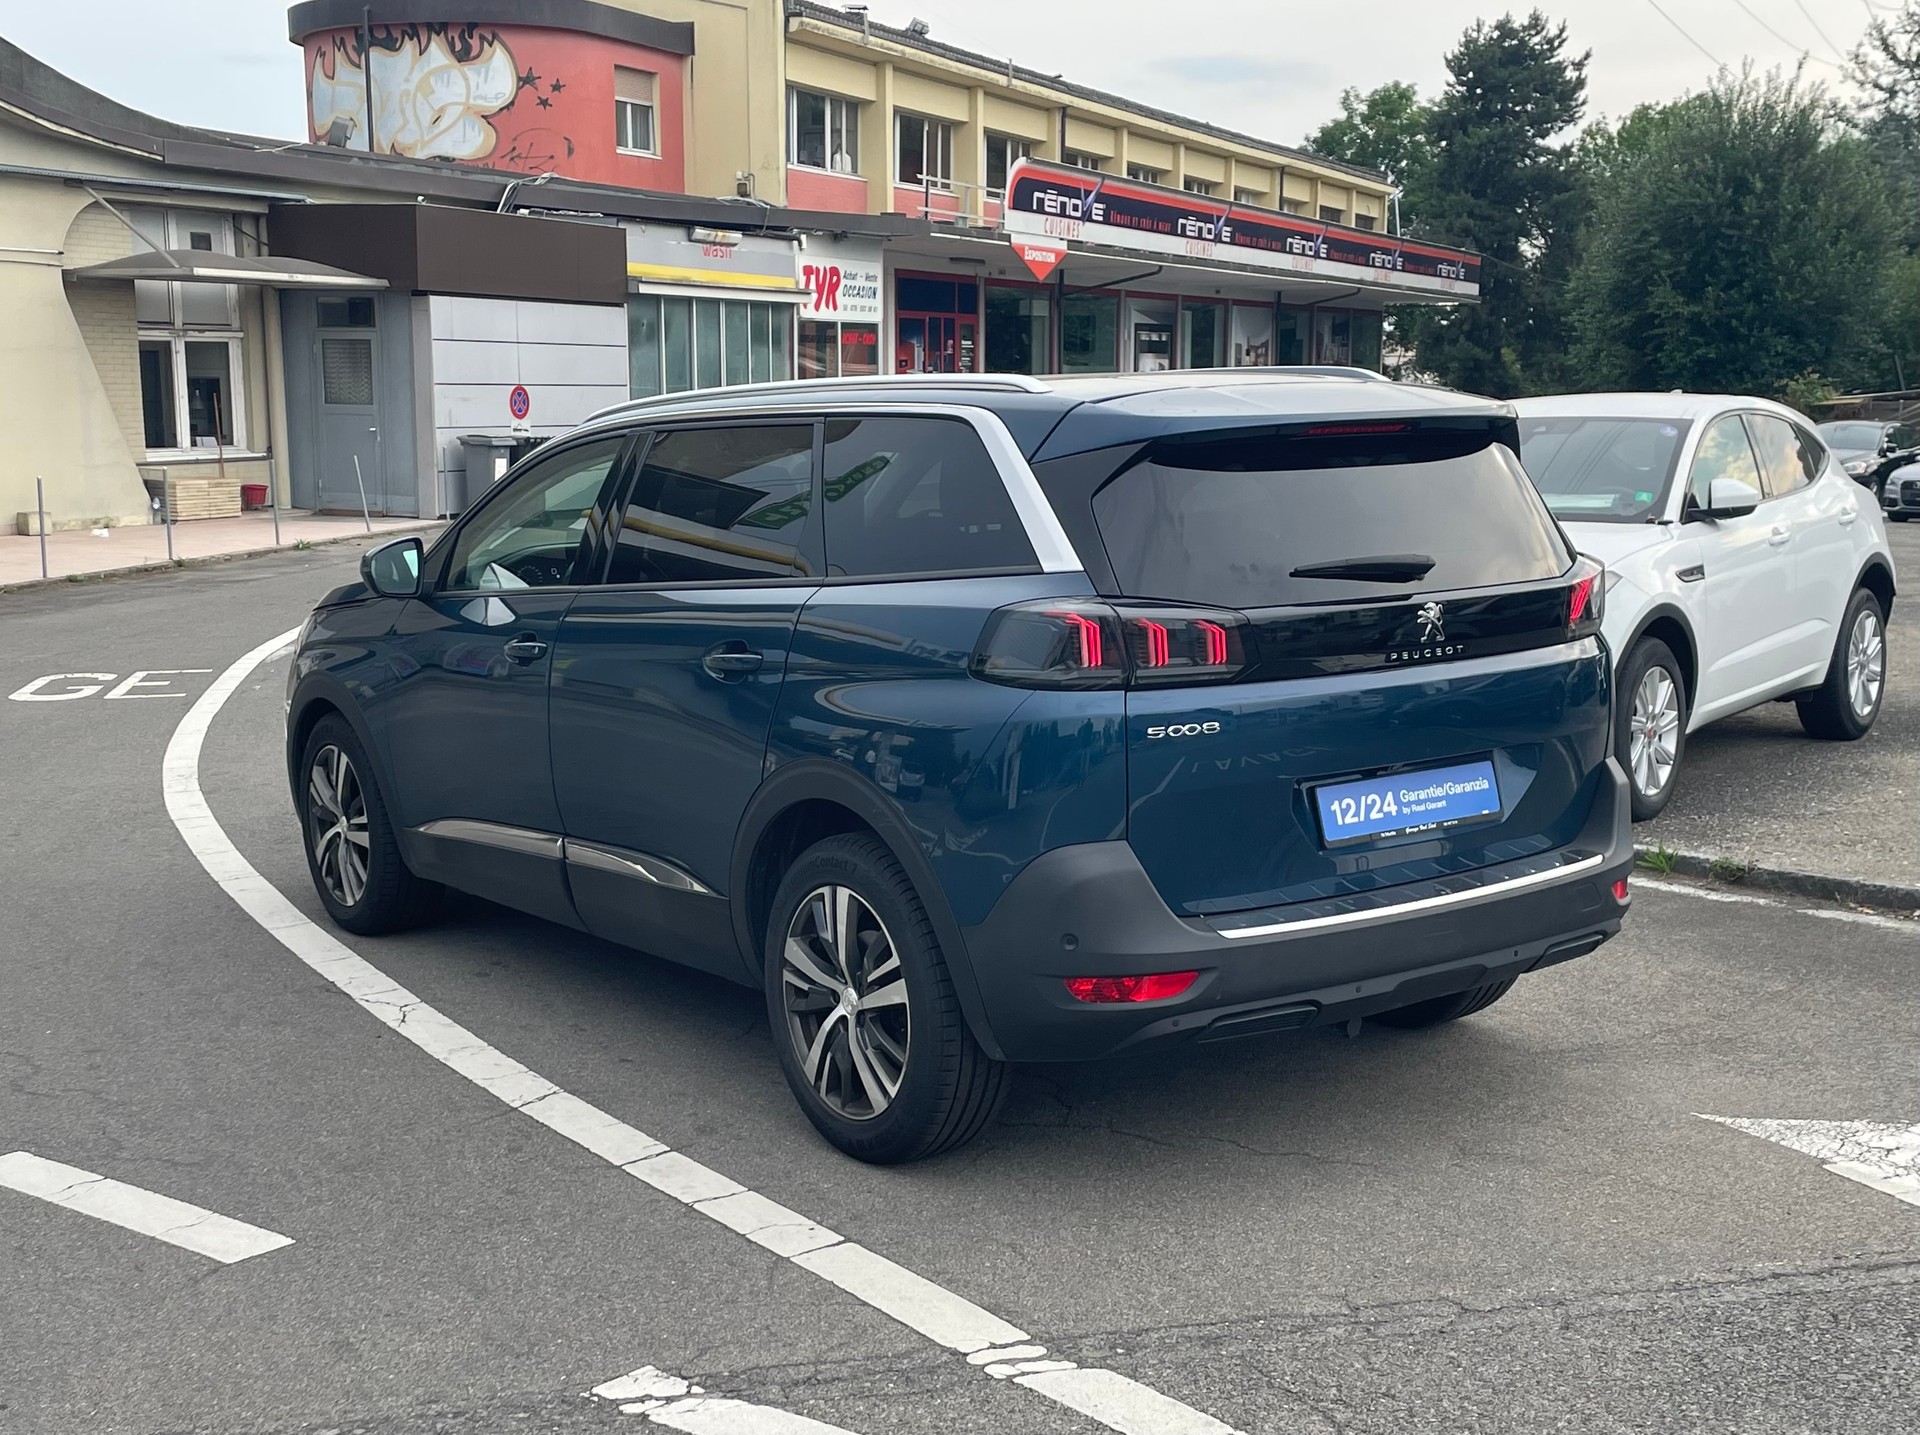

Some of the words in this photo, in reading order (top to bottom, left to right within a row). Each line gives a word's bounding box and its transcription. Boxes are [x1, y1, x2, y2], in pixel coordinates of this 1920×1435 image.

[1044, 217, 1080, 238] CUISINES
[802, 265, 841, 312] TYR
[843, 284, 878, 299] OCCASION
[1390, 645, 1464, 661] PEUGEOT
[8, 669, 213, 701] GE
[1147, 722, 1220, 738] 5008
[1400, 777, 1489, 803] Garantie/Garanzia
[1331, 791, 1398, 825] 12/24
[1402, 806, 1411, 815] by
[1411, 804, 1426, 812] Real
[1425, 800, 1447, 811] Garant
